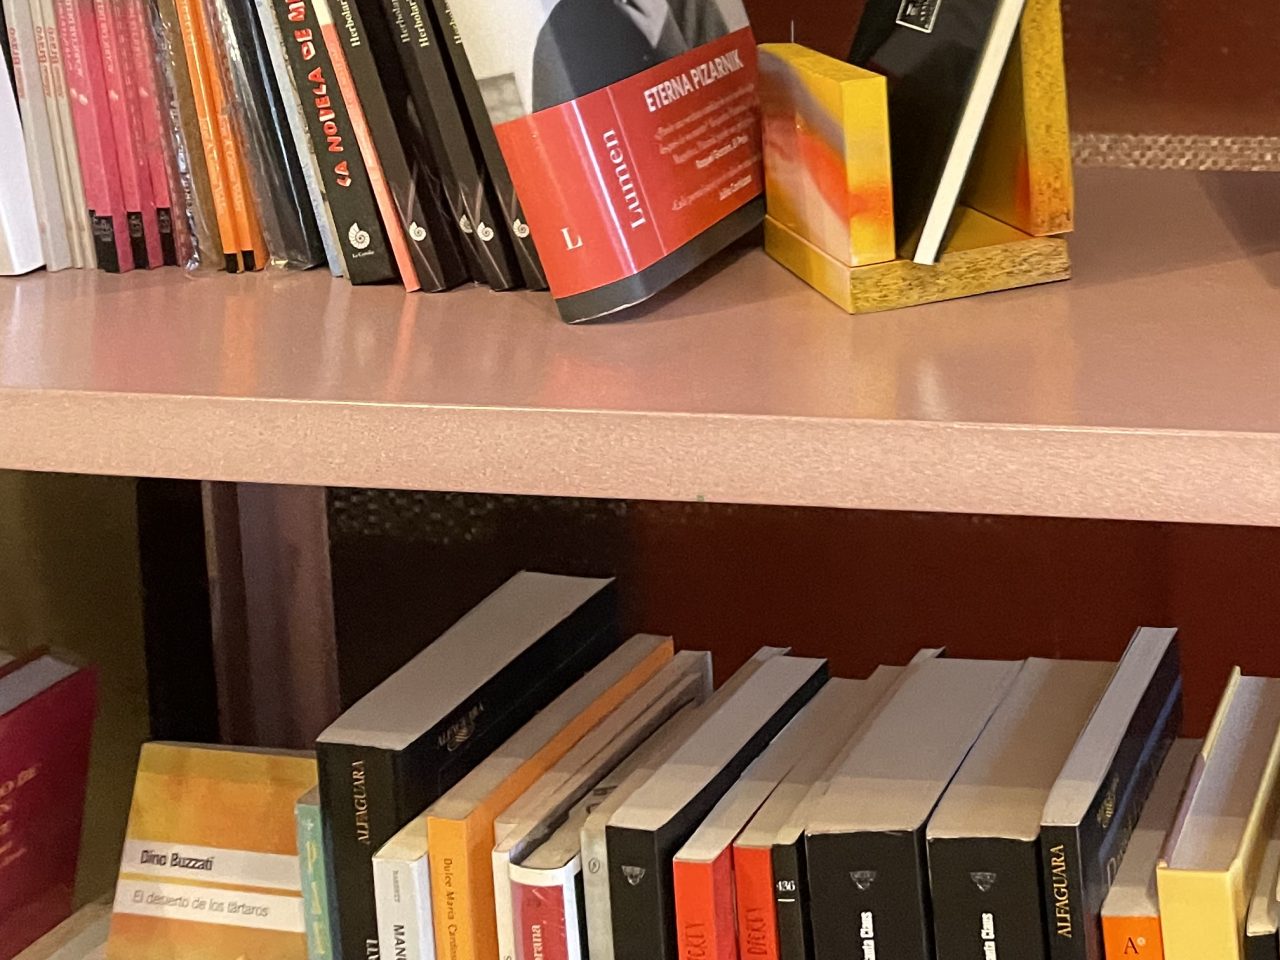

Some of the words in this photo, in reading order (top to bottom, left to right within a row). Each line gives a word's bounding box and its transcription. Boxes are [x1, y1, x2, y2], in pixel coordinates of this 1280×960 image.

[308, 66, 344, 153] NOVELA
[644, 73, 691, 112] ETERNA
[690, 49, 744, 90] PIZARNIK
[603, 130, 647, 229] Lumen
[561, 227, 583, 250] L
[352, 760, 370, 845] ALFAGUARA
[140, 850, 166, 866] Dino
[170, 852, 215, 871] Buzzati
[444, 858, 453, 887] Dulce
[1050, 844, 1072, 938] ALFAGUARA
[133, 890, 143, 903] El
[192, 897, 206, 910] de
[209, 898, 224, 913] los
